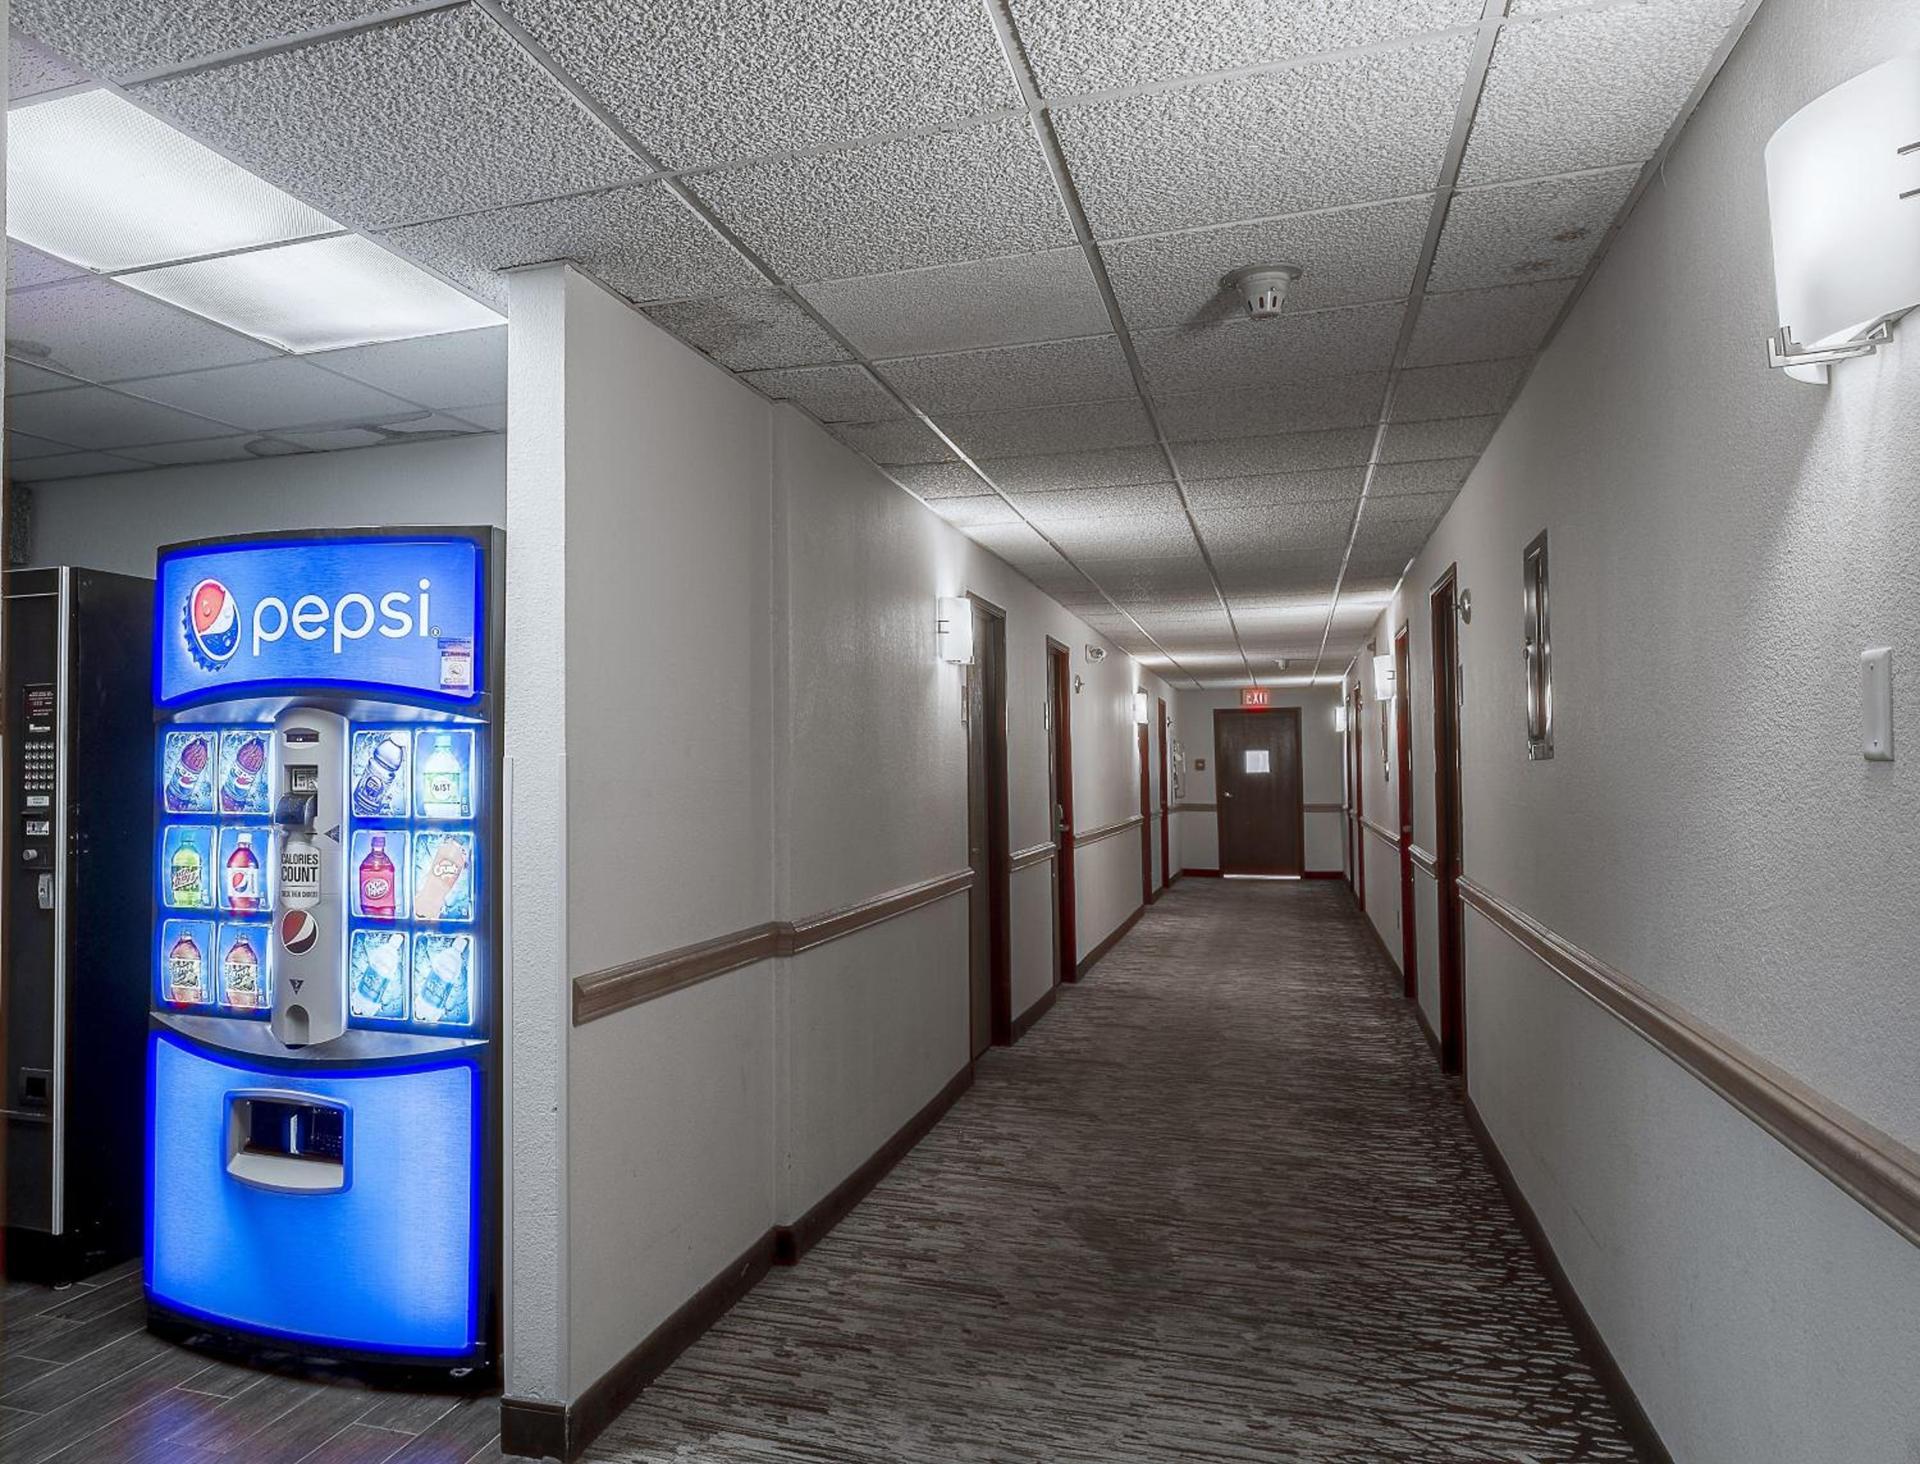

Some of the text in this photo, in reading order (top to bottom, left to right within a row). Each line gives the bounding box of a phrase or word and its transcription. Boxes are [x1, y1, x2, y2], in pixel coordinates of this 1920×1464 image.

[253, 578, 431, 657] pepsi
[1246, 691, 1268, 705] EXIT
[281, 853, 319, 865] CALORIES
[281, 866, 318, 882] COUNT
